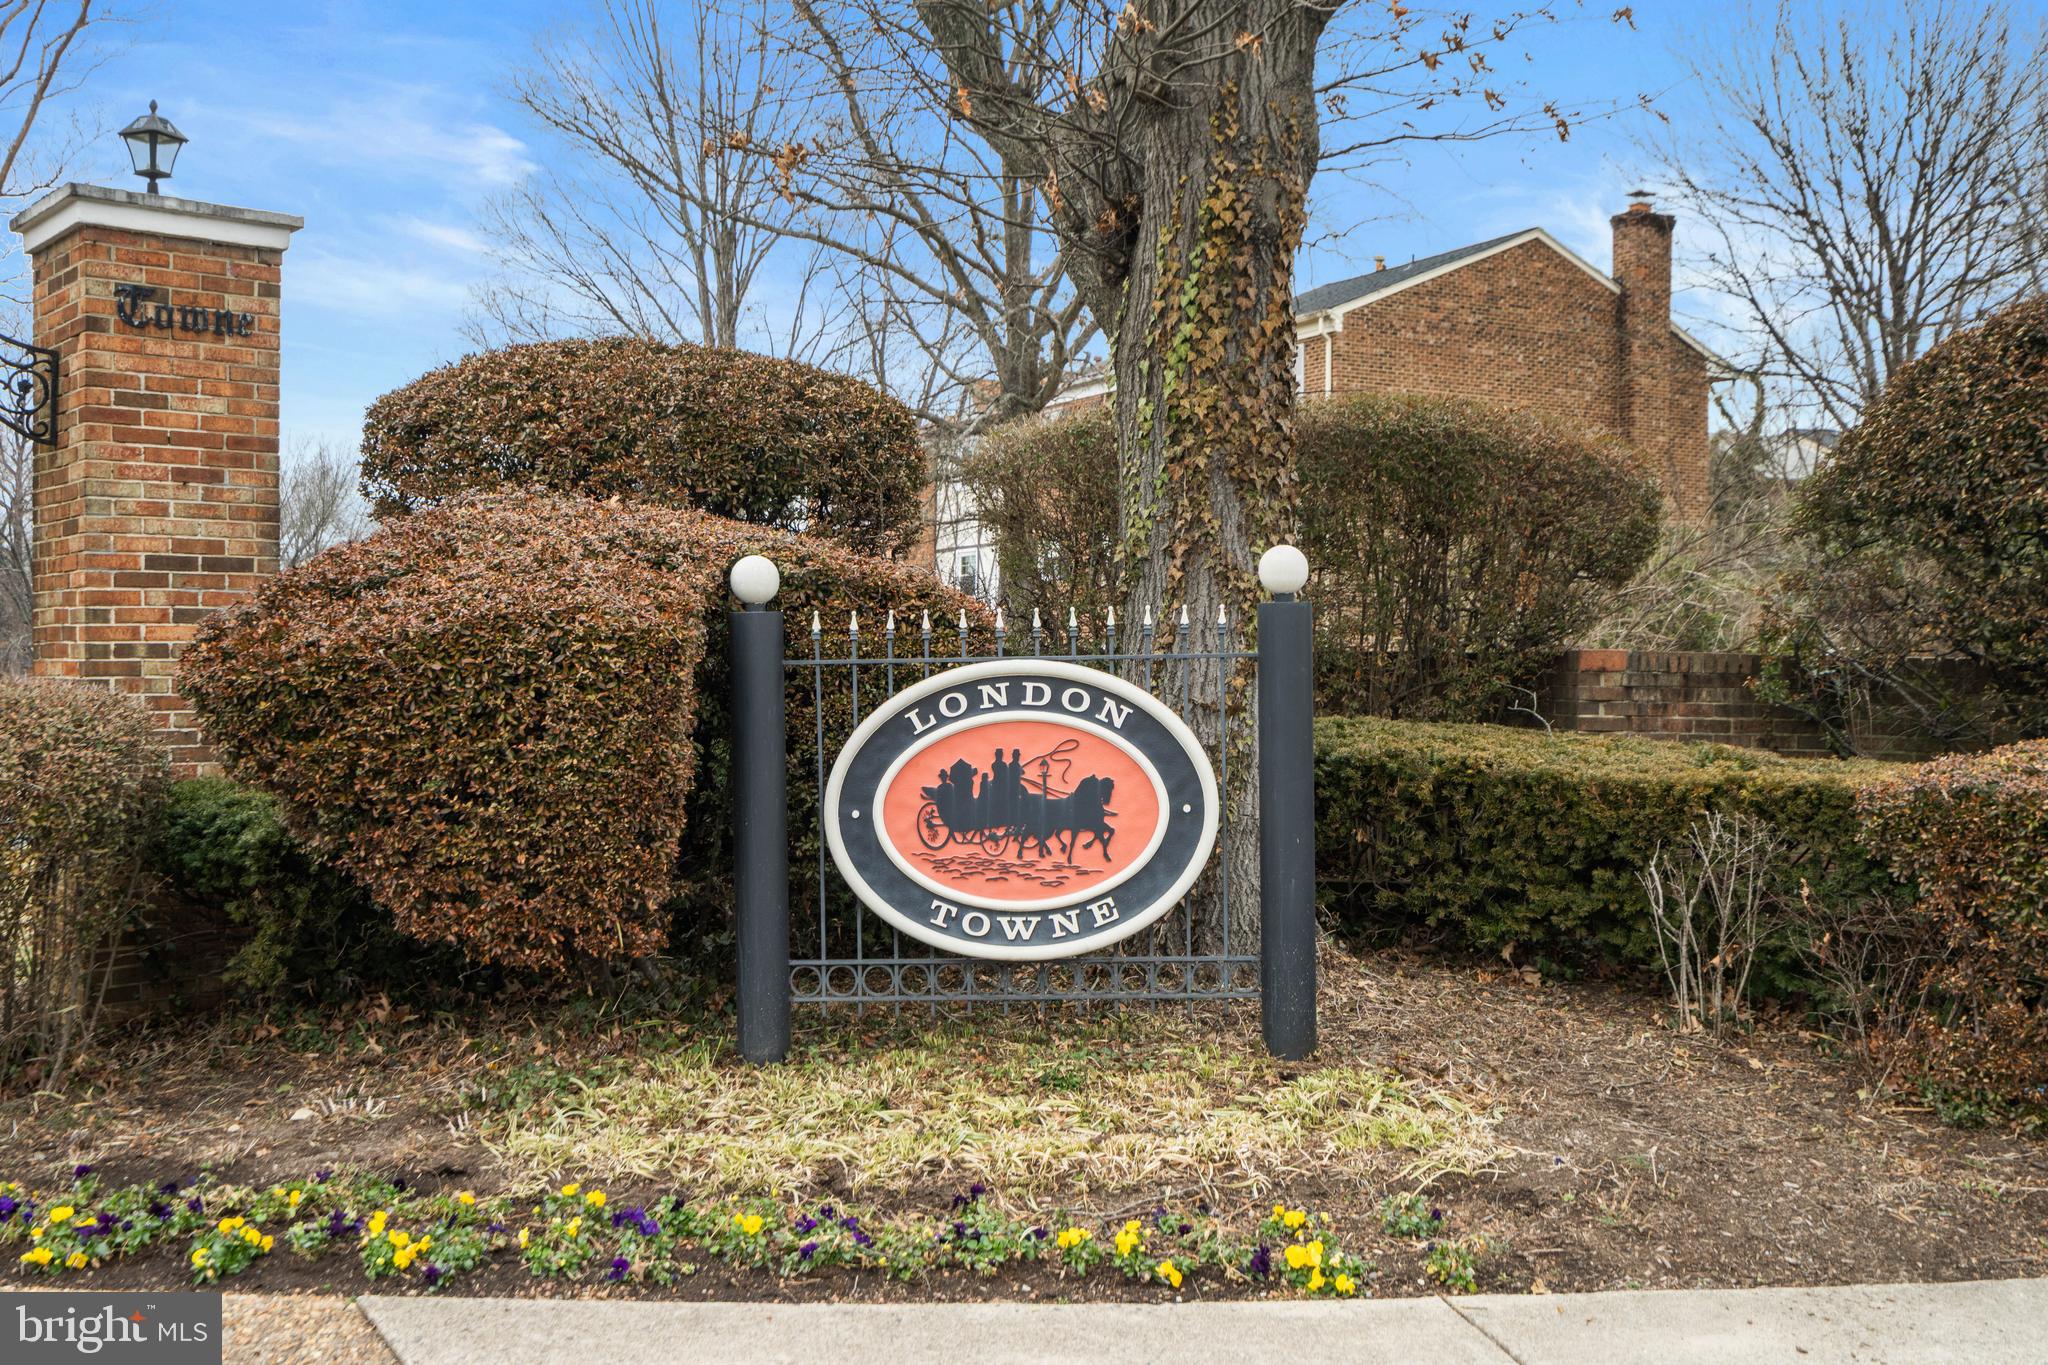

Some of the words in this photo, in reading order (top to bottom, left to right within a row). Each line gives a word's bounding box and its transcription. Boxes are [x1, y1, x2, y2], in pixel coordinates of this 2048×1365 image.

[113, 283, 255, 338] Towne
[904, 681, 1134, 736] LONDON
[929, 896, 1121, 941] TOWNE
